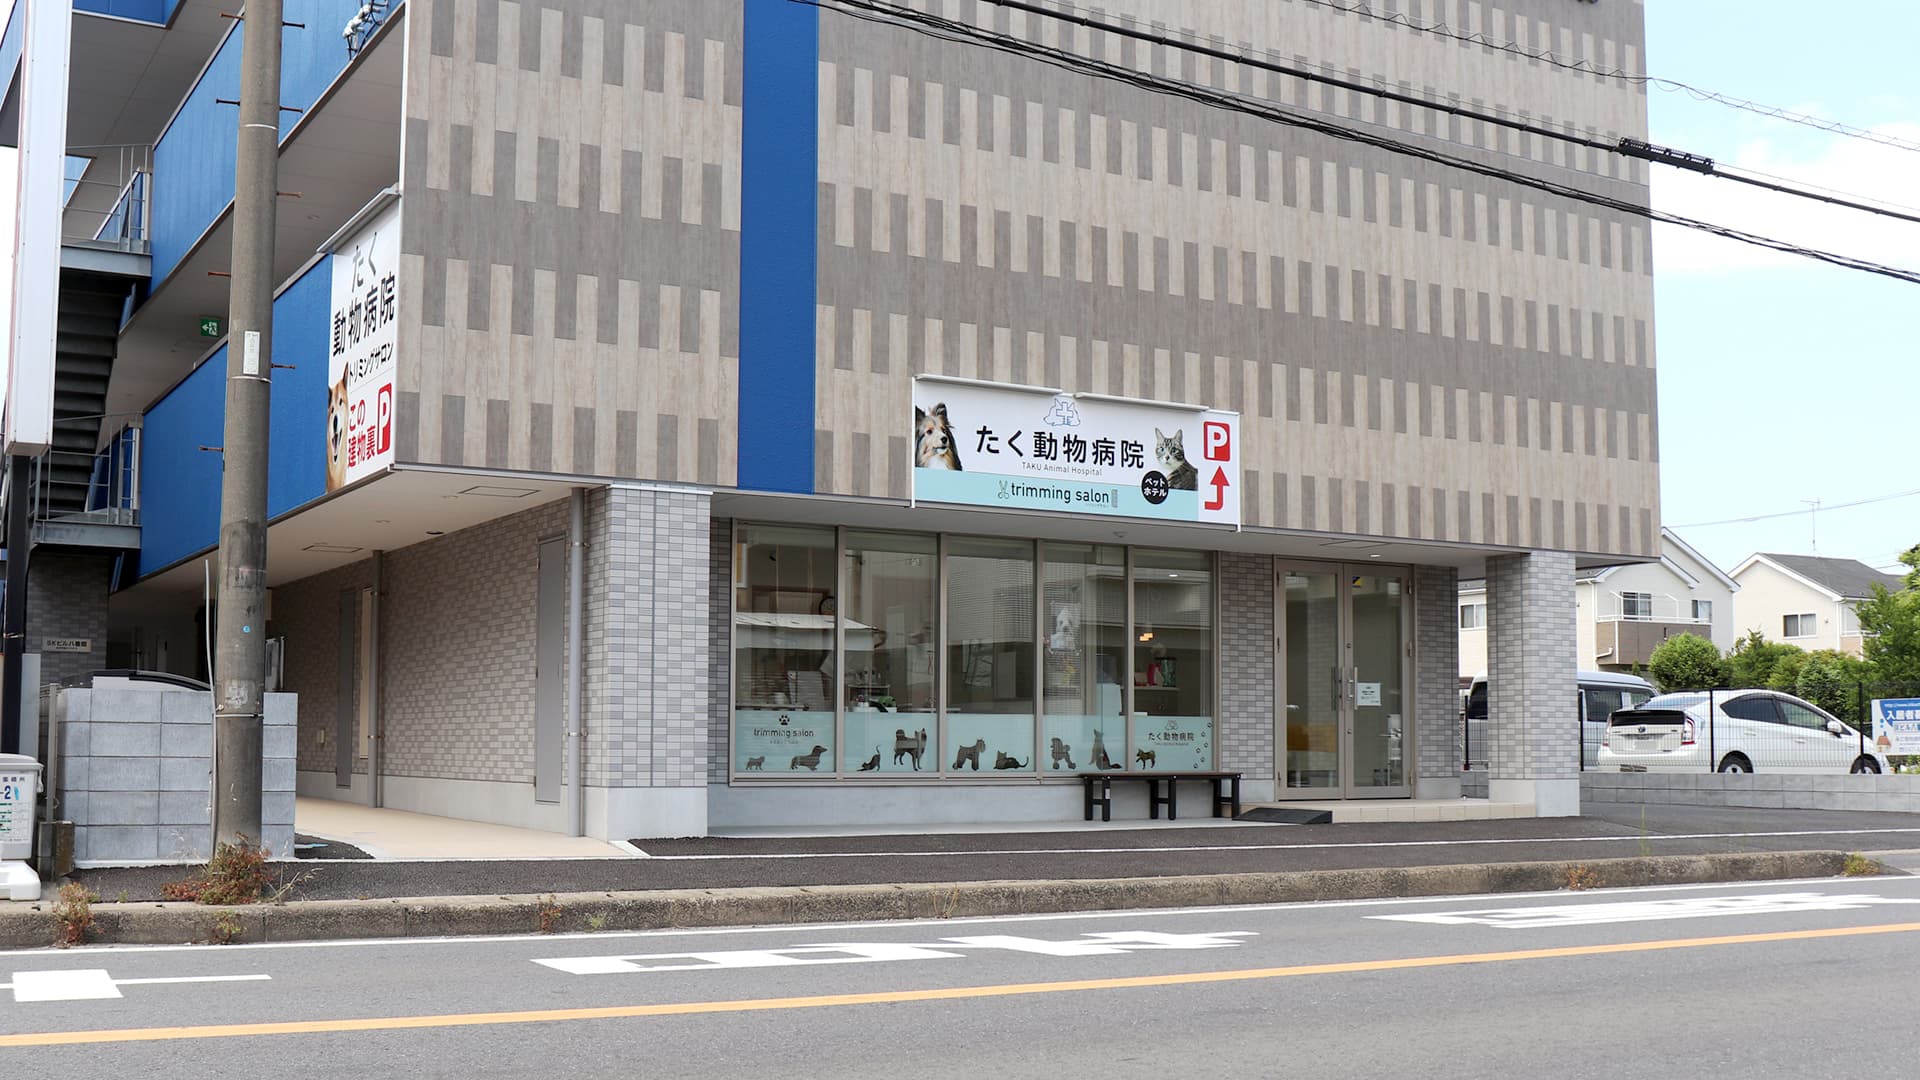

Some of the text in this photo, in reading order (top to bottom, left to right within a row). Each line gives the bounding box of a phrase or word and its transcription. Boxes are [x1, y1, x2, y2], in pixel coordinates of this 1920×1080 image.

[352, 232, 377, 293] たく
[333, 272, 395, 357] 動物病院
[349, 342, 394, 386] トリミングサロン
[349, 399, 366, 431] この
[976, 425, 1145, 469] たく動物病院
[1206, 424, 1228, 459] P
[1022, 461, 1102, 476] TAKU Animal Hospital
[1011, 482, 1109, 504] trimming salon
[1143, 487, 1167, 497] ホテル
[1145, 478, 1166, 487] ペット
[753, 728, 814, 739] trimming salon
[1148, 732, 1195, 742] たく動物病院
